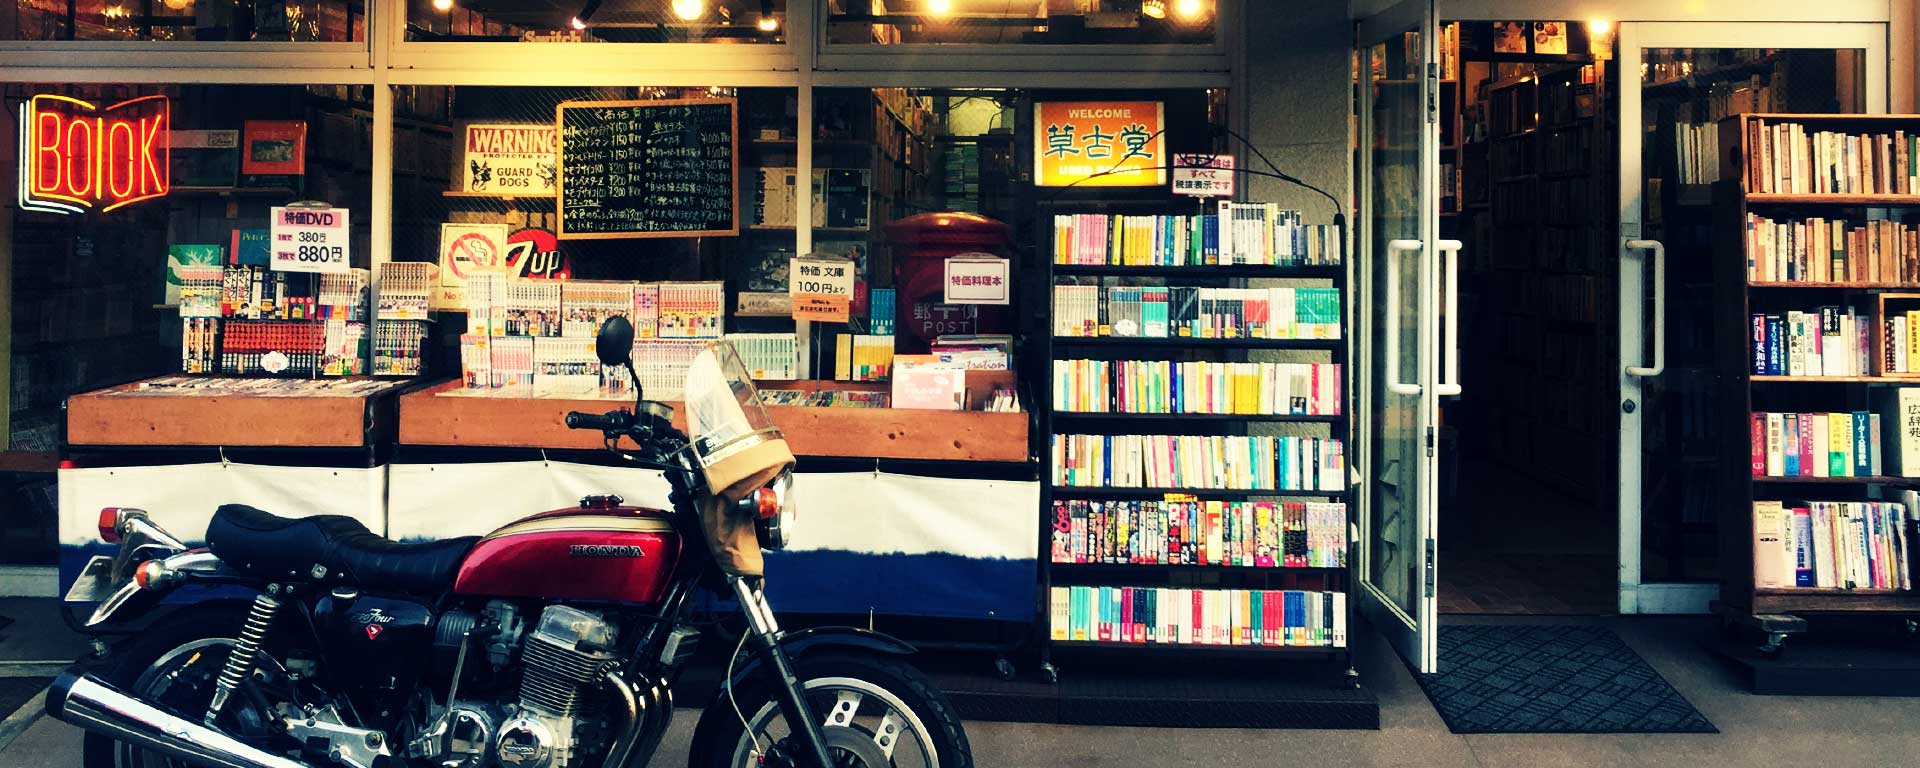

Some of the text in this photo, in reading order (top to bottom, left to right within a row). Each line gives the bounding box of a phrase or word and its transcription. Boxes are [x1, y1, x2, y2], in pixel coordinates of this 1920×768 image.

[1068, 109, 1132, 119] WELCOME
[1045, 125, 1153, 159] 草古堂
[39, 112, 163, 198] BOOK
[497, 168, 533, 177] GUARD
[1191, 170, 1216, 179] すべて
[499, 178, 529, 188] DOGS
[285, 212, 333, 226] 特価DVD
[800, 265, 844, 277] 特価 文庫
[951, 275, 1003, 286] 特価料理本
[923, 321, 969, 333] POST
[568, 544, 646, 557] HONDA
